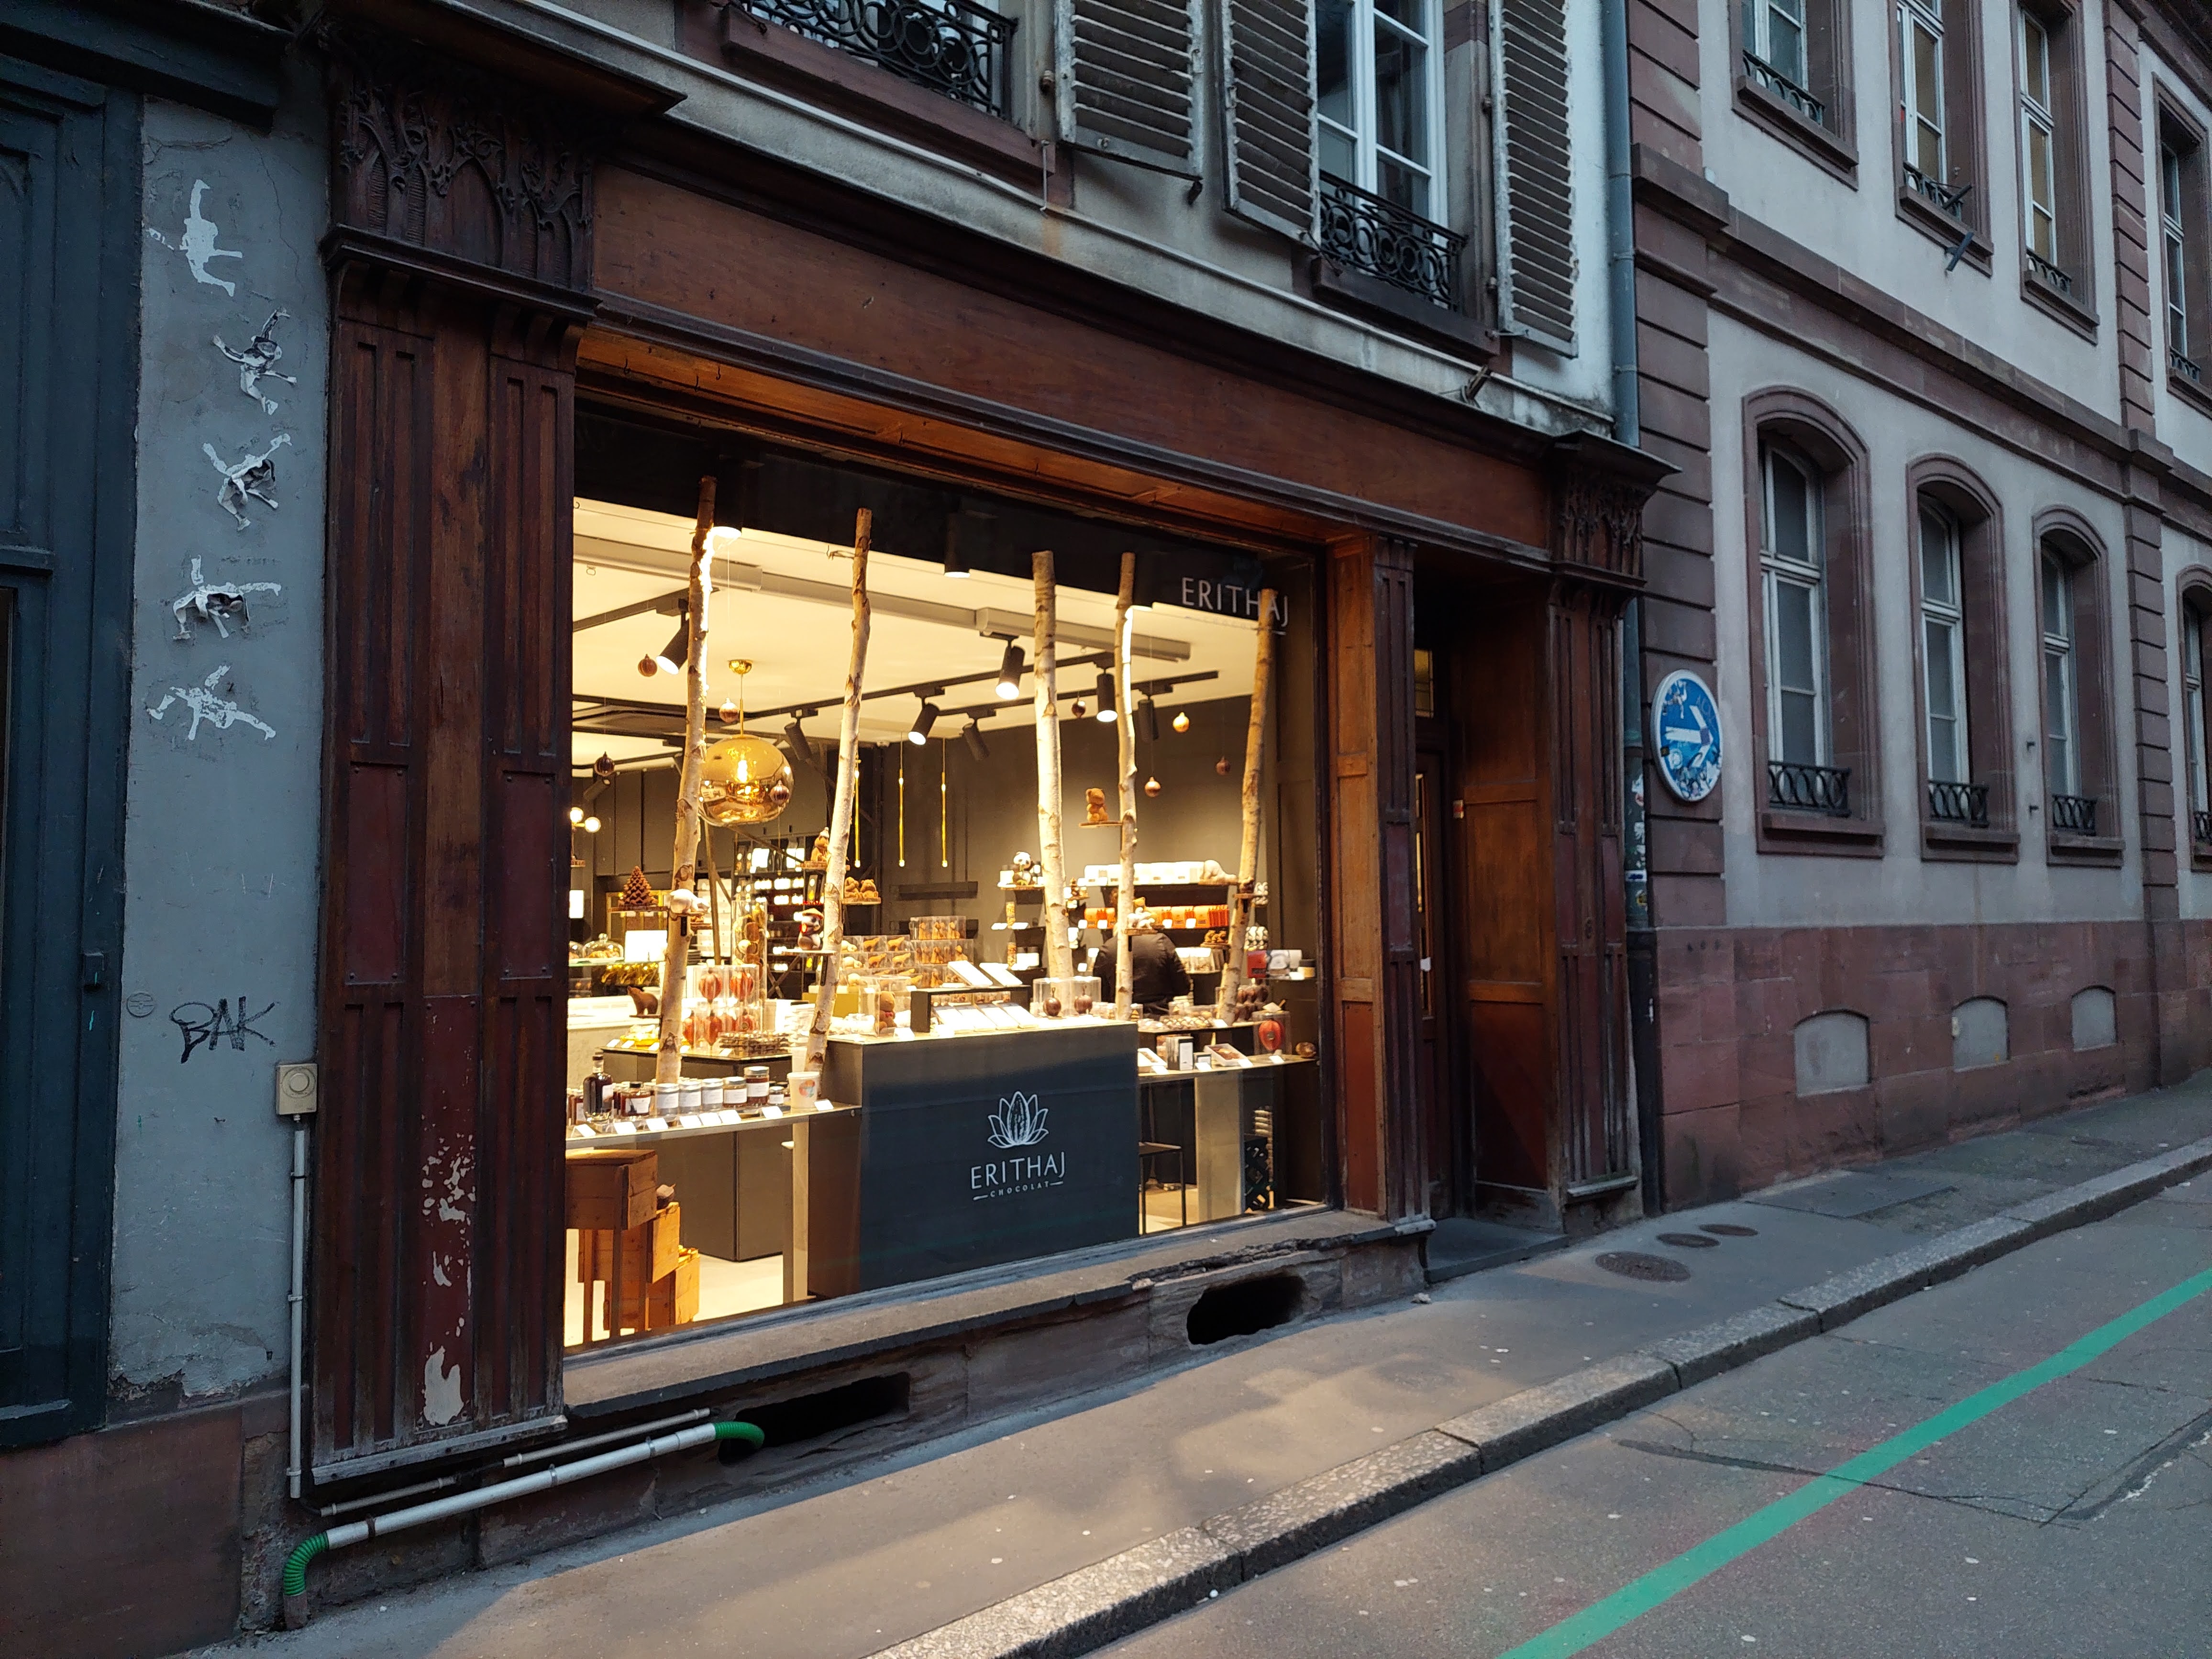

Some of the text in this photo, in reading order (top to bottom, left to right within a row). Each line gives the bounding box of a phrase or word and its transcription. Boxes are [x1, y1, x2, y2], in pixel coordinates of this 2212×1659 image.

[1182, 577, 1288, 627] ERITHAJ
[971, 1151, 1065, 1189] ERITHAJ
[990, 1181, 1049, 1197] CHOCOLAT
